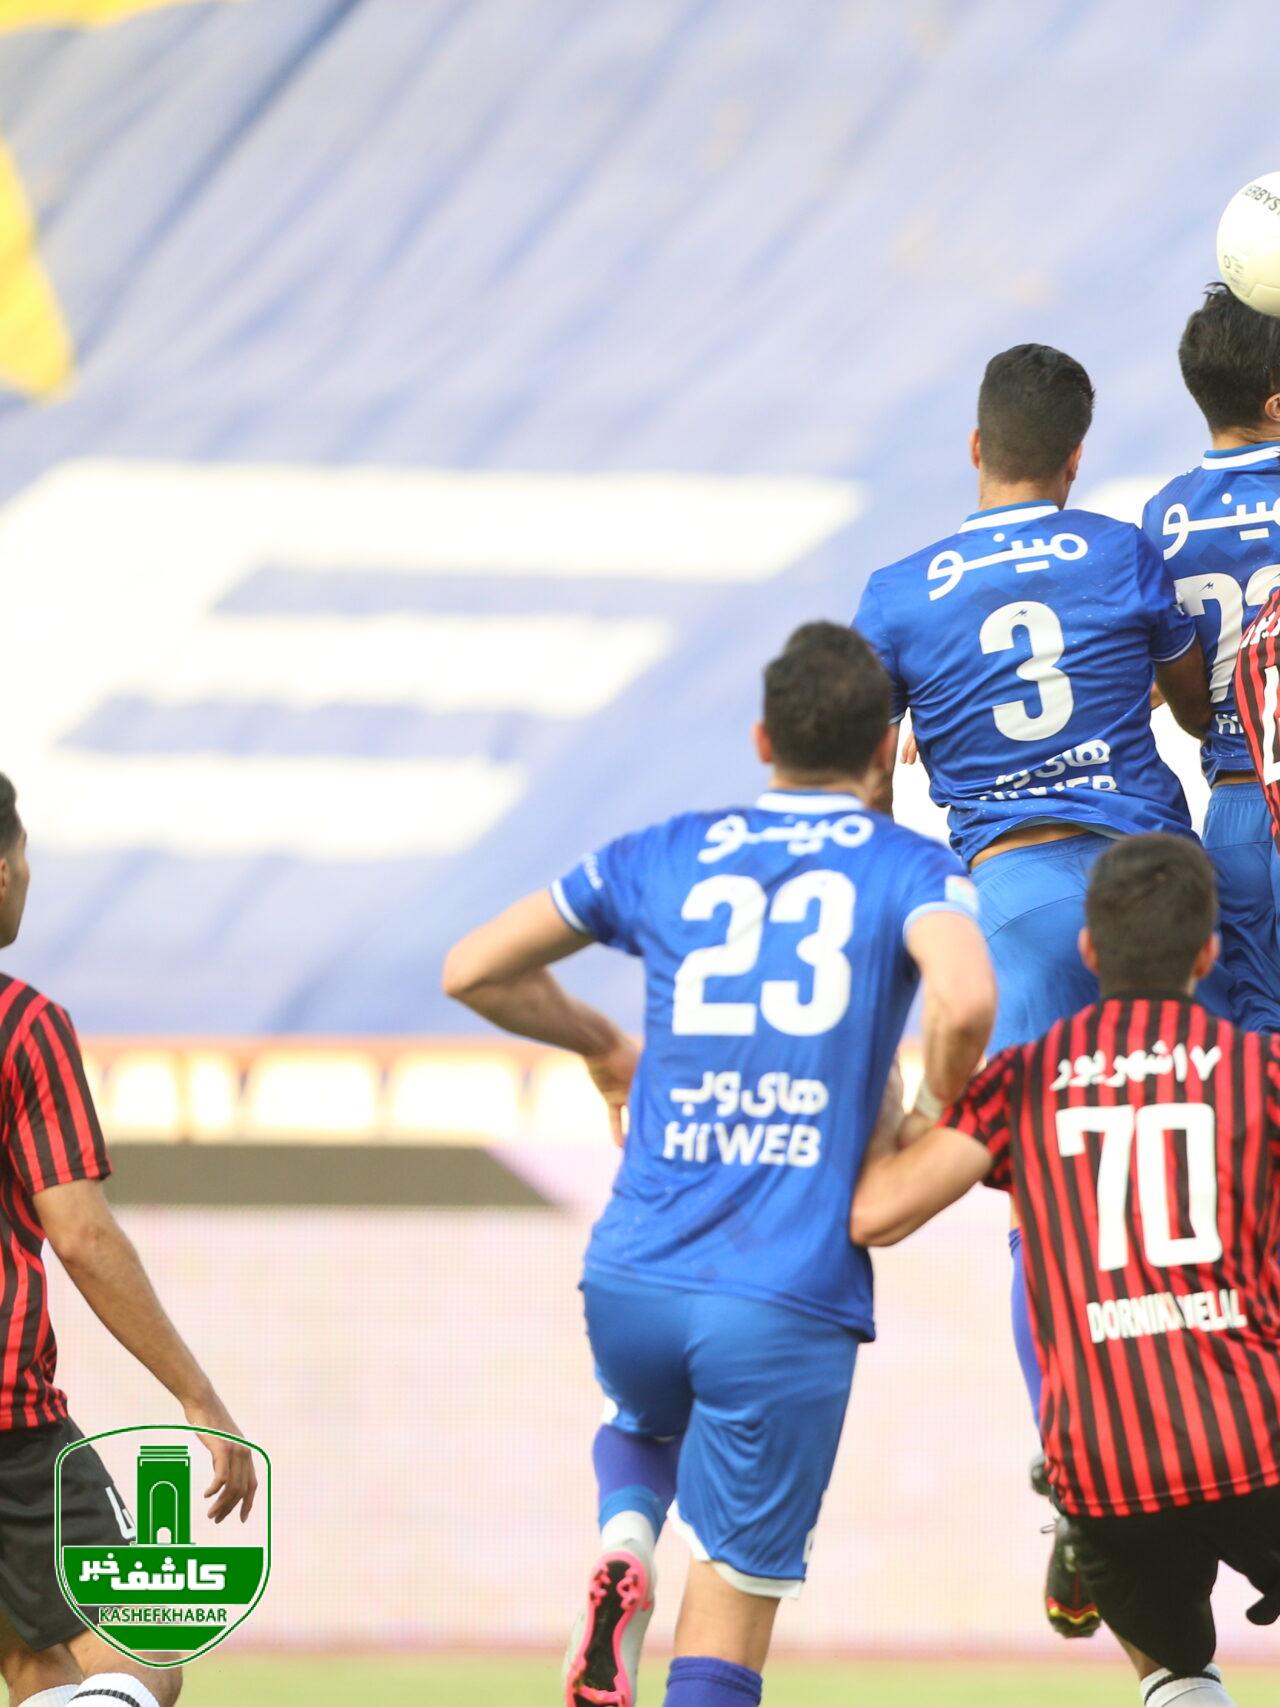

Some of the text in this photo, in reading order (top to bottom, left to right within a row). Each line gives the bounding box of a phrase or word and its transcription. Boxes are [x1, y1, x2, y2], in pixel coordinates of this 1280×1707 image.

[927, 531, 1088, 601] مینو
[979, 600, 1075, 742] 3
[697, 814, 875, 864] مینو
[671, 869, 857, 1037] 23
[1055, 1102, 1223, 1272] 70
[1086, 1291, 1186, 1344] DORNIKA
